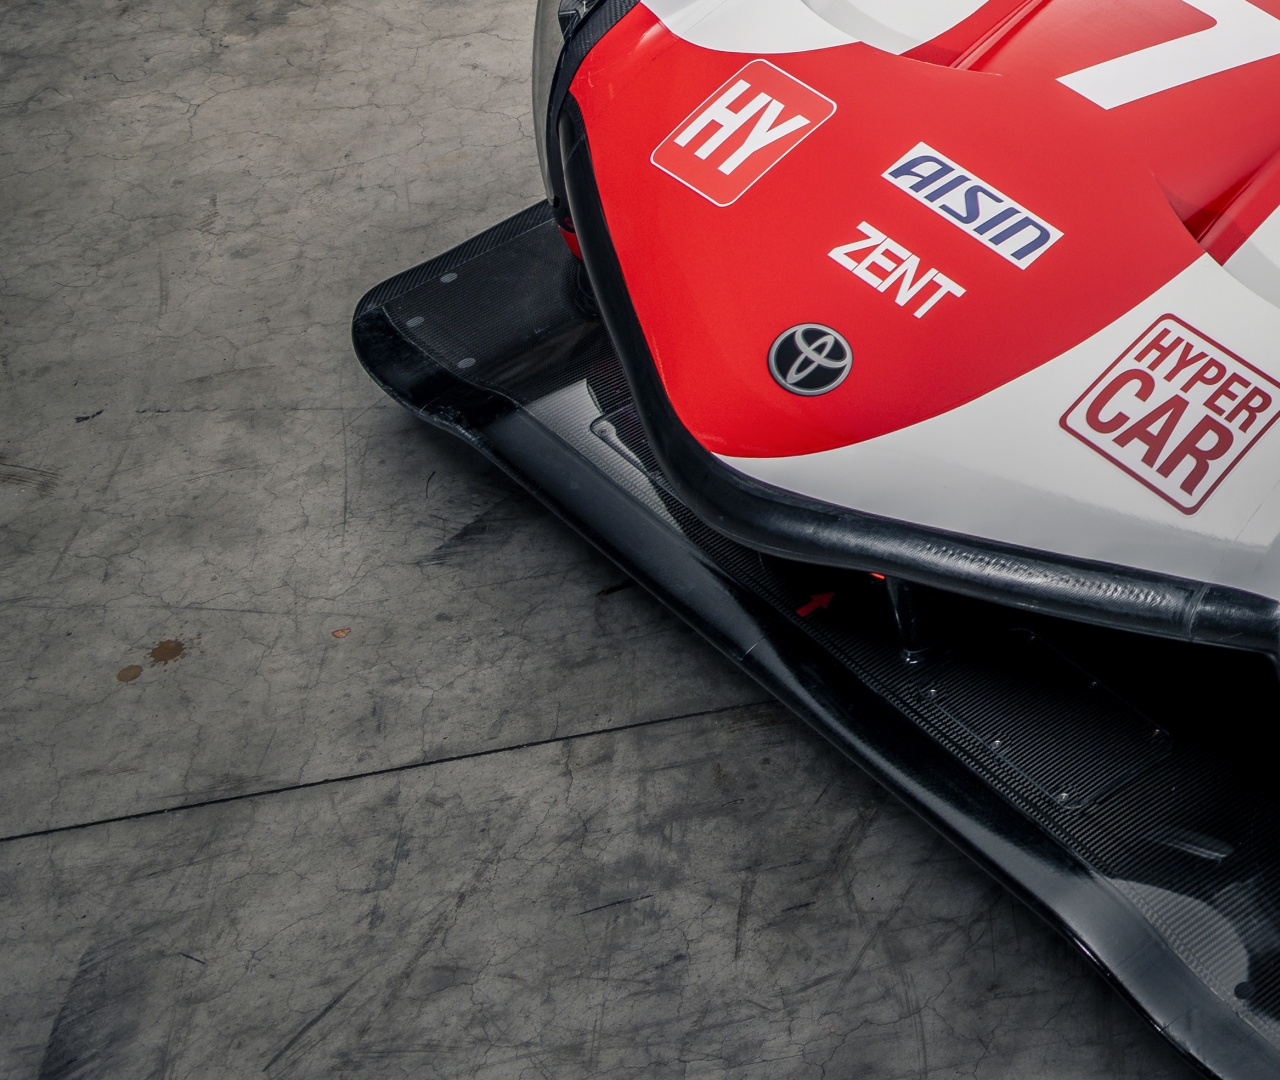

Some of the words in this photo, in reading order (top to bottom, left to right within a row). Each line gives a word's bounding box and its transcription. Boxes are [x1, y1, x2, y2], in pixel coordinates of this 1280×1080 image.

[673, 79, 811, 176] HY
[887, 155, 1051, 261] AISIN
[827, 221, 967, 319] ZENT
[1086, 368, 1235, 497] CAR
[1133, 328, 1272, 433] HYPER
